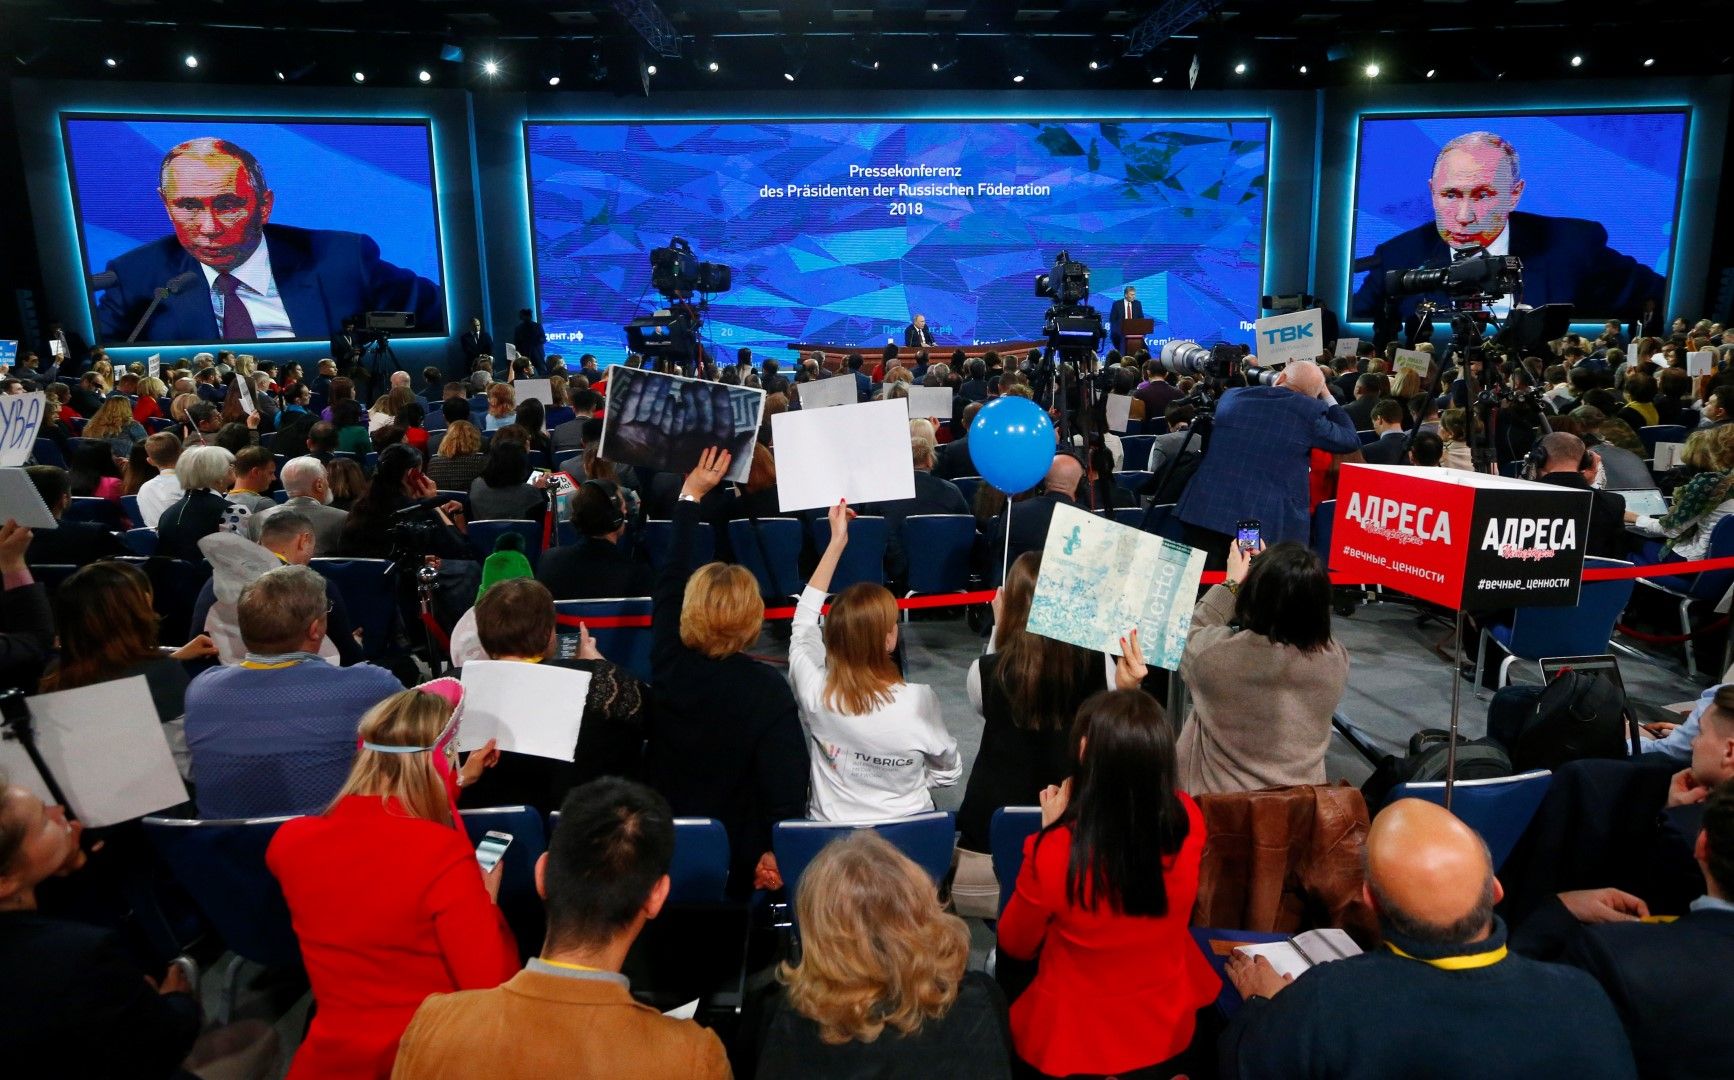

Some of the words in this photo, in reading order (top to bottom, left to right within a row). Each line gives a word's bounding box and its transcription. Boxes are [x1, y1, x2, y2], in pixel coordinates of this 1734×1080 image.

[849, 164, 962, 178] Pressekonferenz
[759, 185, 784, 198] des
[787, 184, 870, 198] Präsidenten
[872, 184, 896, 197] der
[898, 183, 974, 197] Russischen
[977, 182, 1050, 196] Föderation
[889, 203, 923, 215] 2018
[1345, 491, 1452, 545] АДРЕСА
[1481, 517, 1576, 556] АДРЕСА
[1343, 545, 1445, 584] #вечные_ценности
[1477, 577, 1570, 590] #вечные_ценности
[854, 752, 871, 762] TV
[872, 757, 914, 767] BRICS
